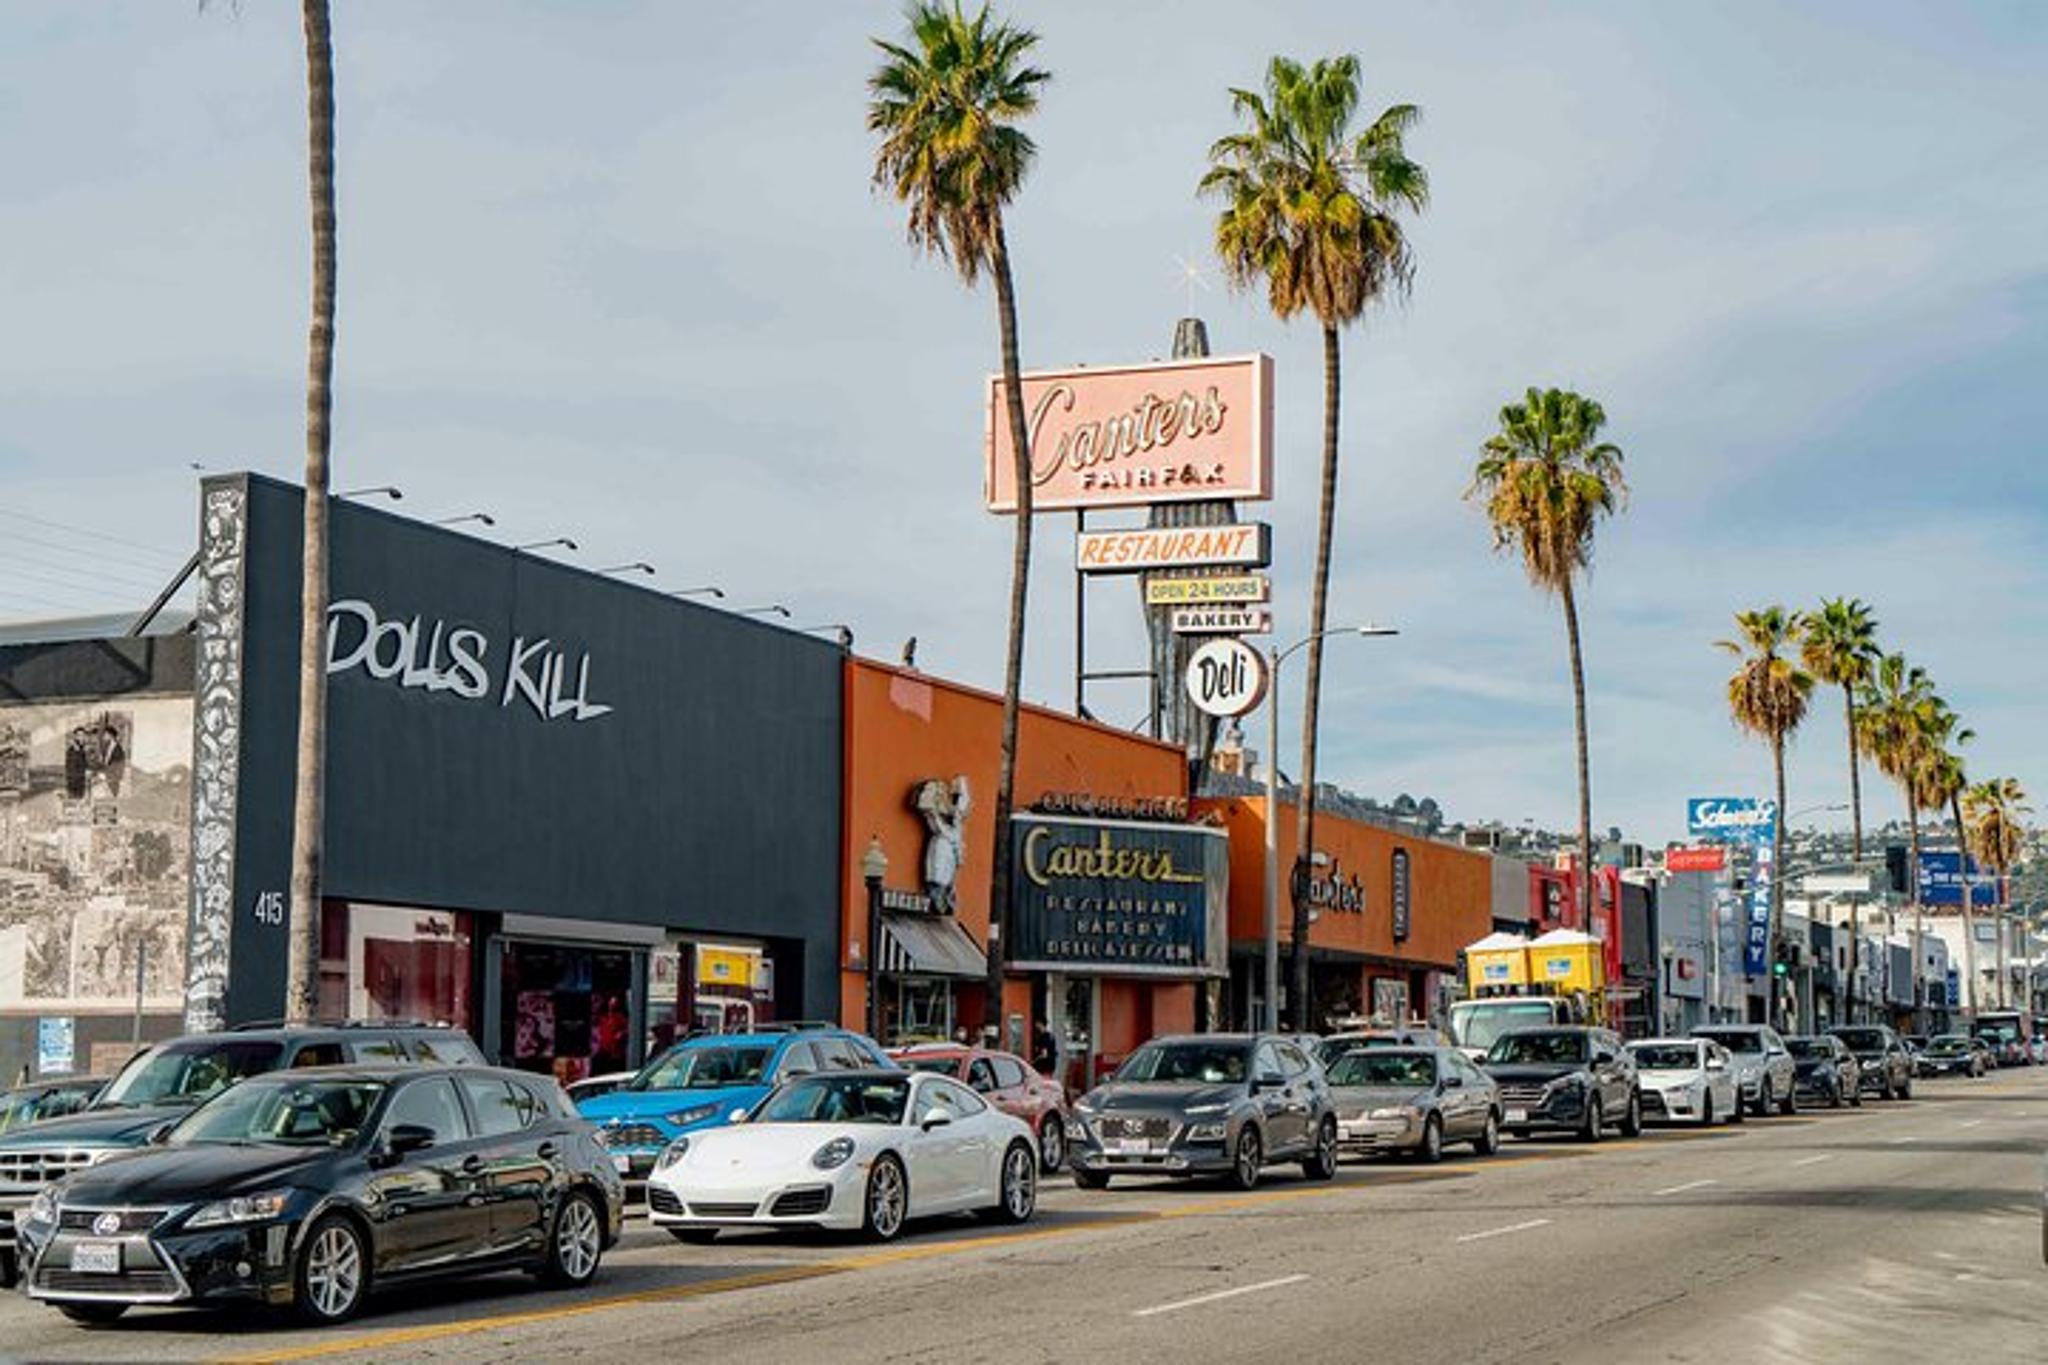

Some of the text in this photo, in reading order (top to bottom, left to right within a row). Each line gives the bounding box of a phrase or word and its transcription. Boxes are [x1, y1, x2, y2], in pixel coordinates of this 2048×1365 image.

[1082, 463, 1226, 490] FAIRFAX
[1081, 529, 1253, 564] RESTAURANT
[1151, 580, 1258, 598] OPEN 24 HOURS
[1177, 612, 1253, 627] BAKERY
[326, 600, 614, 721] DOLLS KILL
[1197, 648, 1246, 702] Deli
[255, 891, 283, 925] 415
[1046, 895, 1187, 916] RESTAURANT
[1750, 847, 1773, 963] BAKERY
[1077, 918, 1167, 937] BAKERY
[1046, 940, 1192, 960] DELICATESSEN
